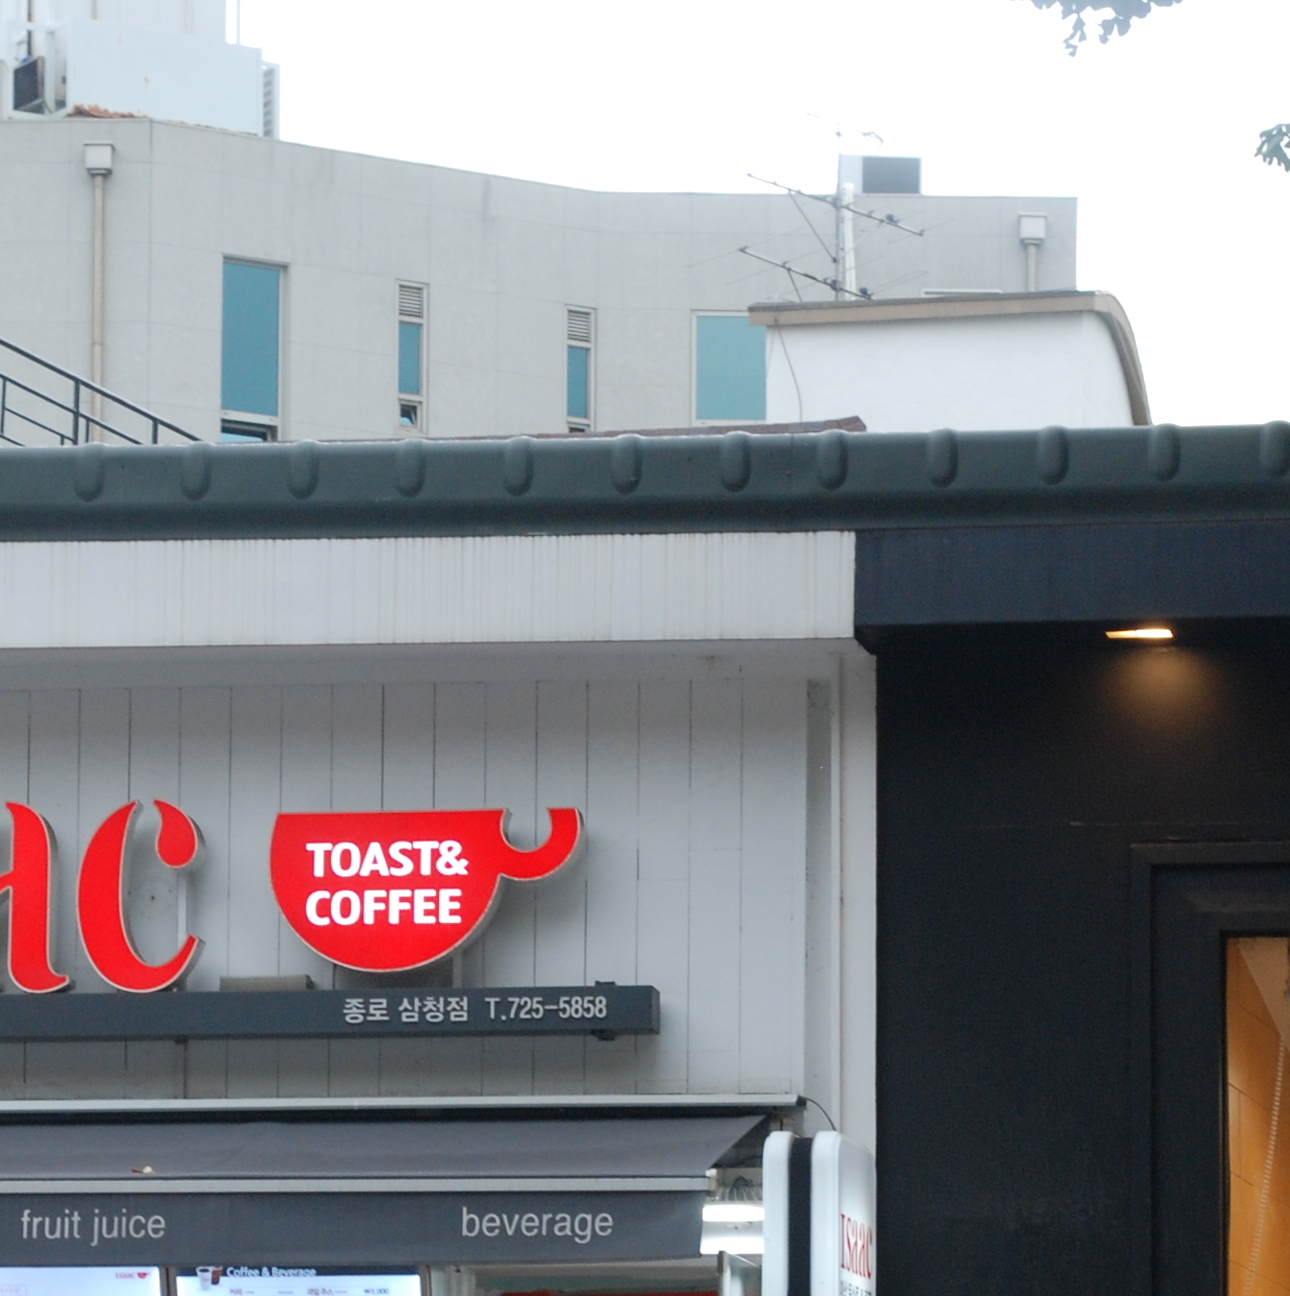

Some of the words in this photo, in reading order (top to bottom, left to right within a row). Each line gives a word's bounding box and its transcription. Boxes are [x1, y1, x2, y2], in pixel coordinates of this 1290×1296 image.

[305, 840, 469, 877] TOAST&
[305, 888, 462, 926] COFFEE
[342, 997, 390, 1024] 종로
[398, 996, 469, 1023] 삼청점
[484, 996, 607, 1020] T.725-5858
[20, 1208, 81, 1240] fruit
[90, 1208, 166, 1246] juice
[460, 1206, 613, 1244] beverage
[226, 1266, 260, 1277] Coffee
